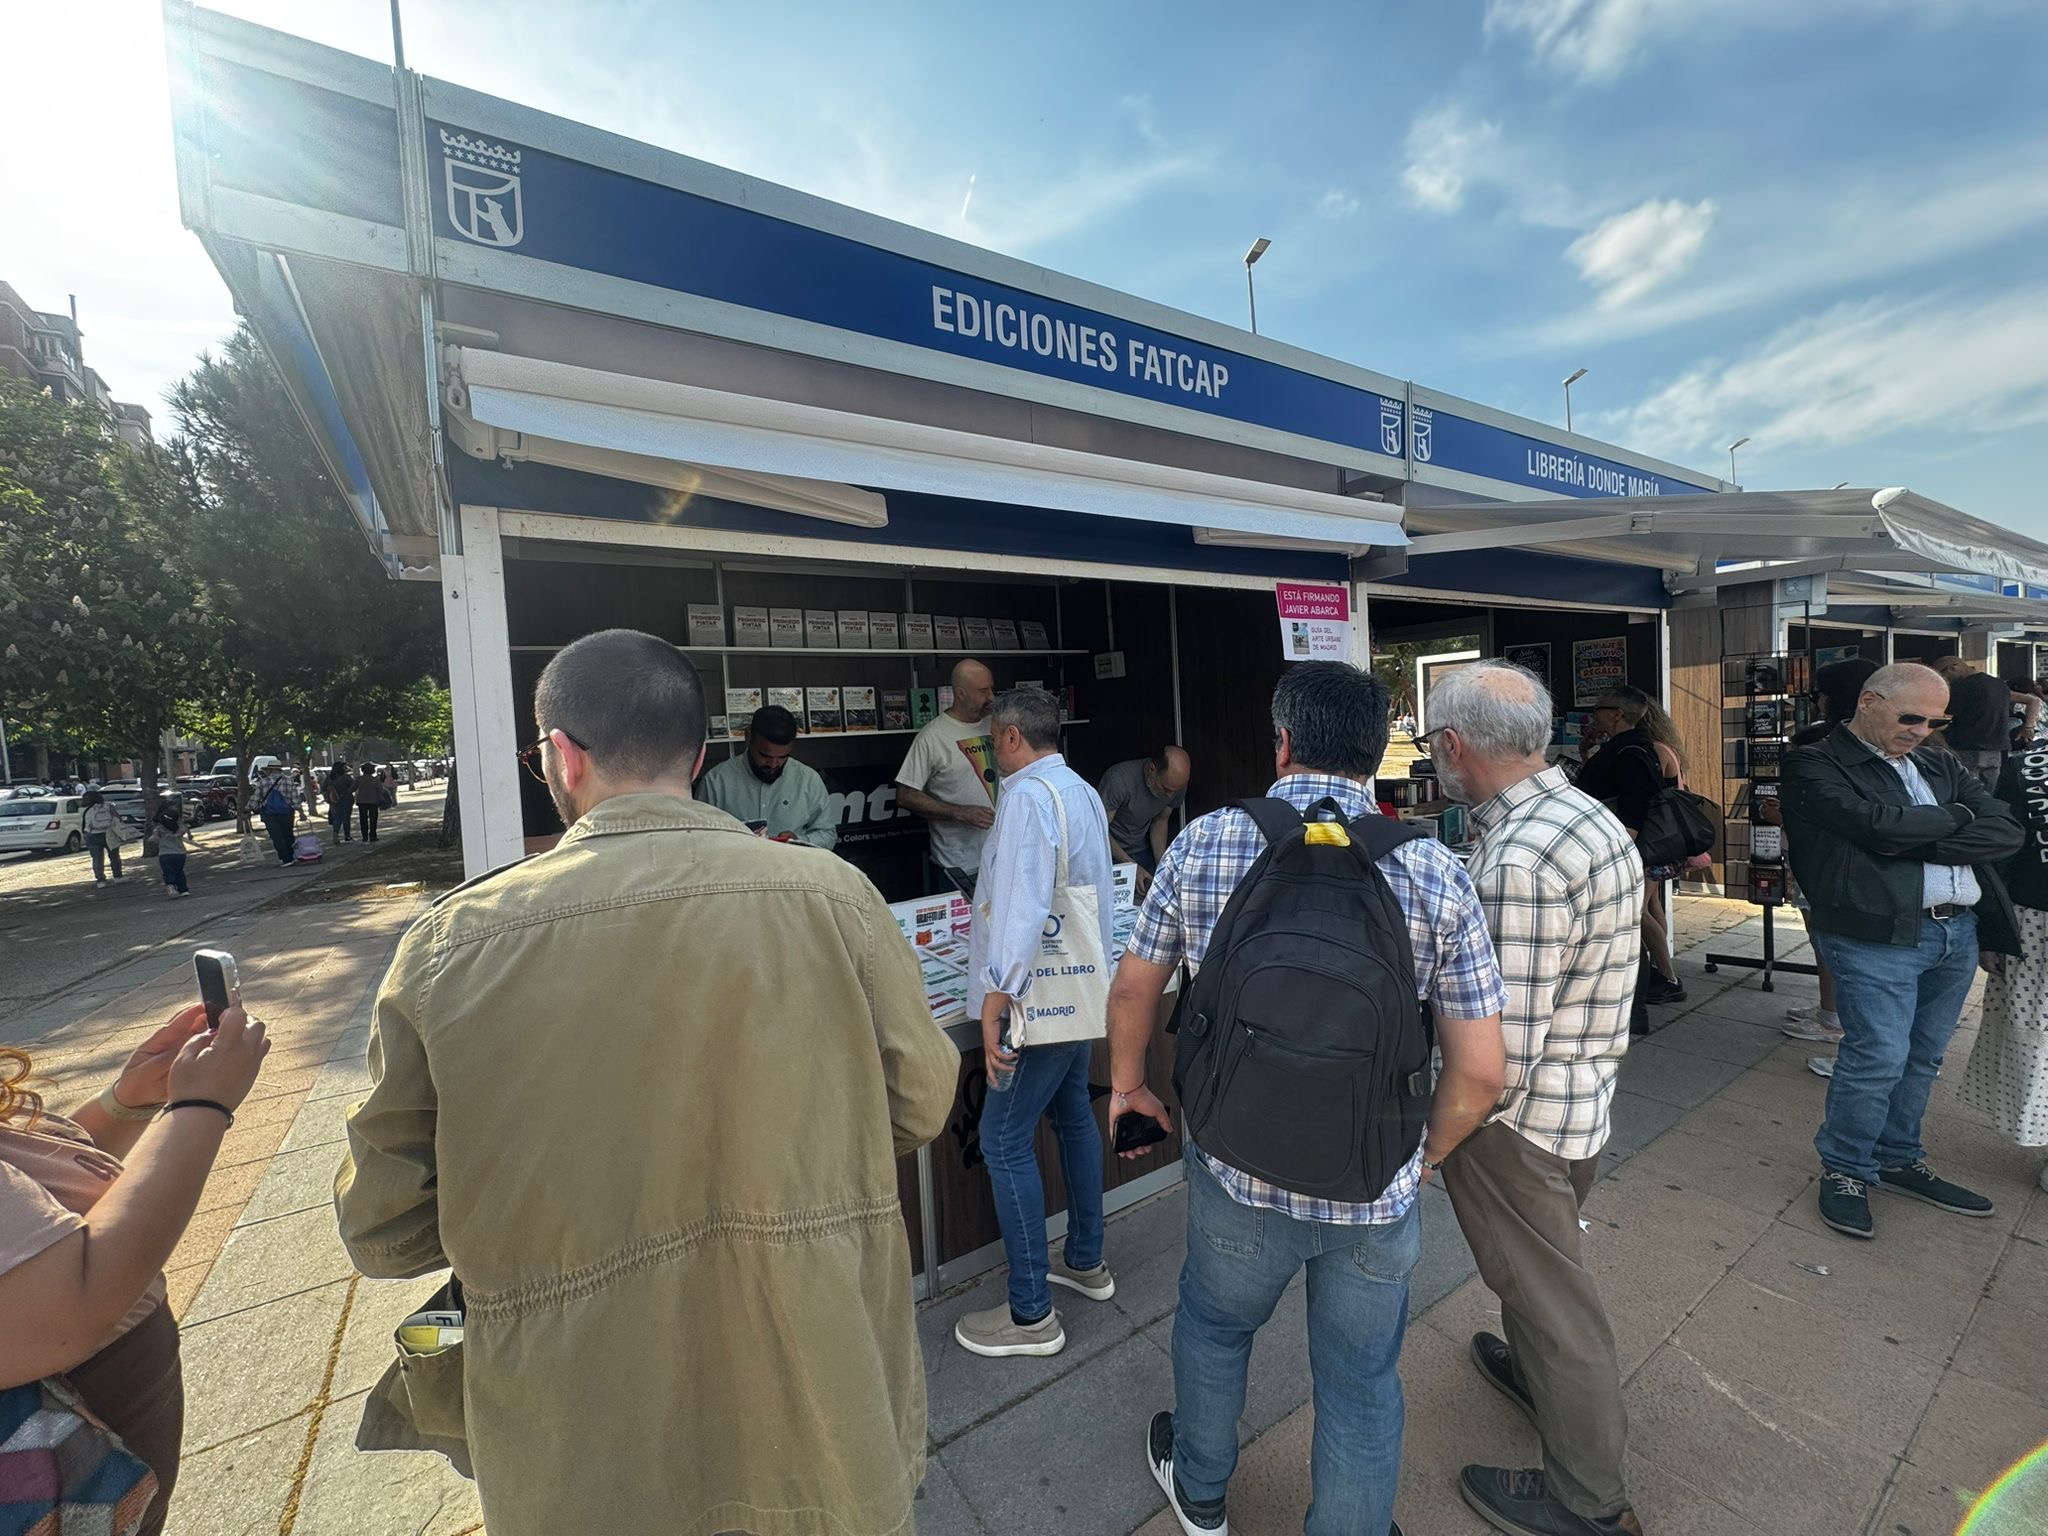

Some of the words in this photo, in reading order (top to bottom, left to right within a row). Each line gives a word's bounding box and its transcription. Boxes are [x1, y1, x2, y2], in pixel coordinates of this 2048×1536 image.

[932, 285, 1117, 372] EDICIONES
[1129, 339, 1229, 398] FATCAP
[1527, 449, 1585, 487] LIBRERÍA
[1589, 466, 1625, 496] DONDE
[1628, 476, 1660, 497] MARÍA
[1284, 590, 1302, 600] ESTÁ
[1303, 592, 1340, 602] FIRMANDO
[1285, 604, 1309, 615] JAVIER
[1311, 606, 1339, 616] ABARCA
[1584, 667, 1619, 676] REGALO
[843, 833, 870, 843] Colors
[1036, 967, 1058, 977] DEL
[1061, 964, 1096, 976] LIBRO
[1037, 1005, 1076, 1018] MADRID
